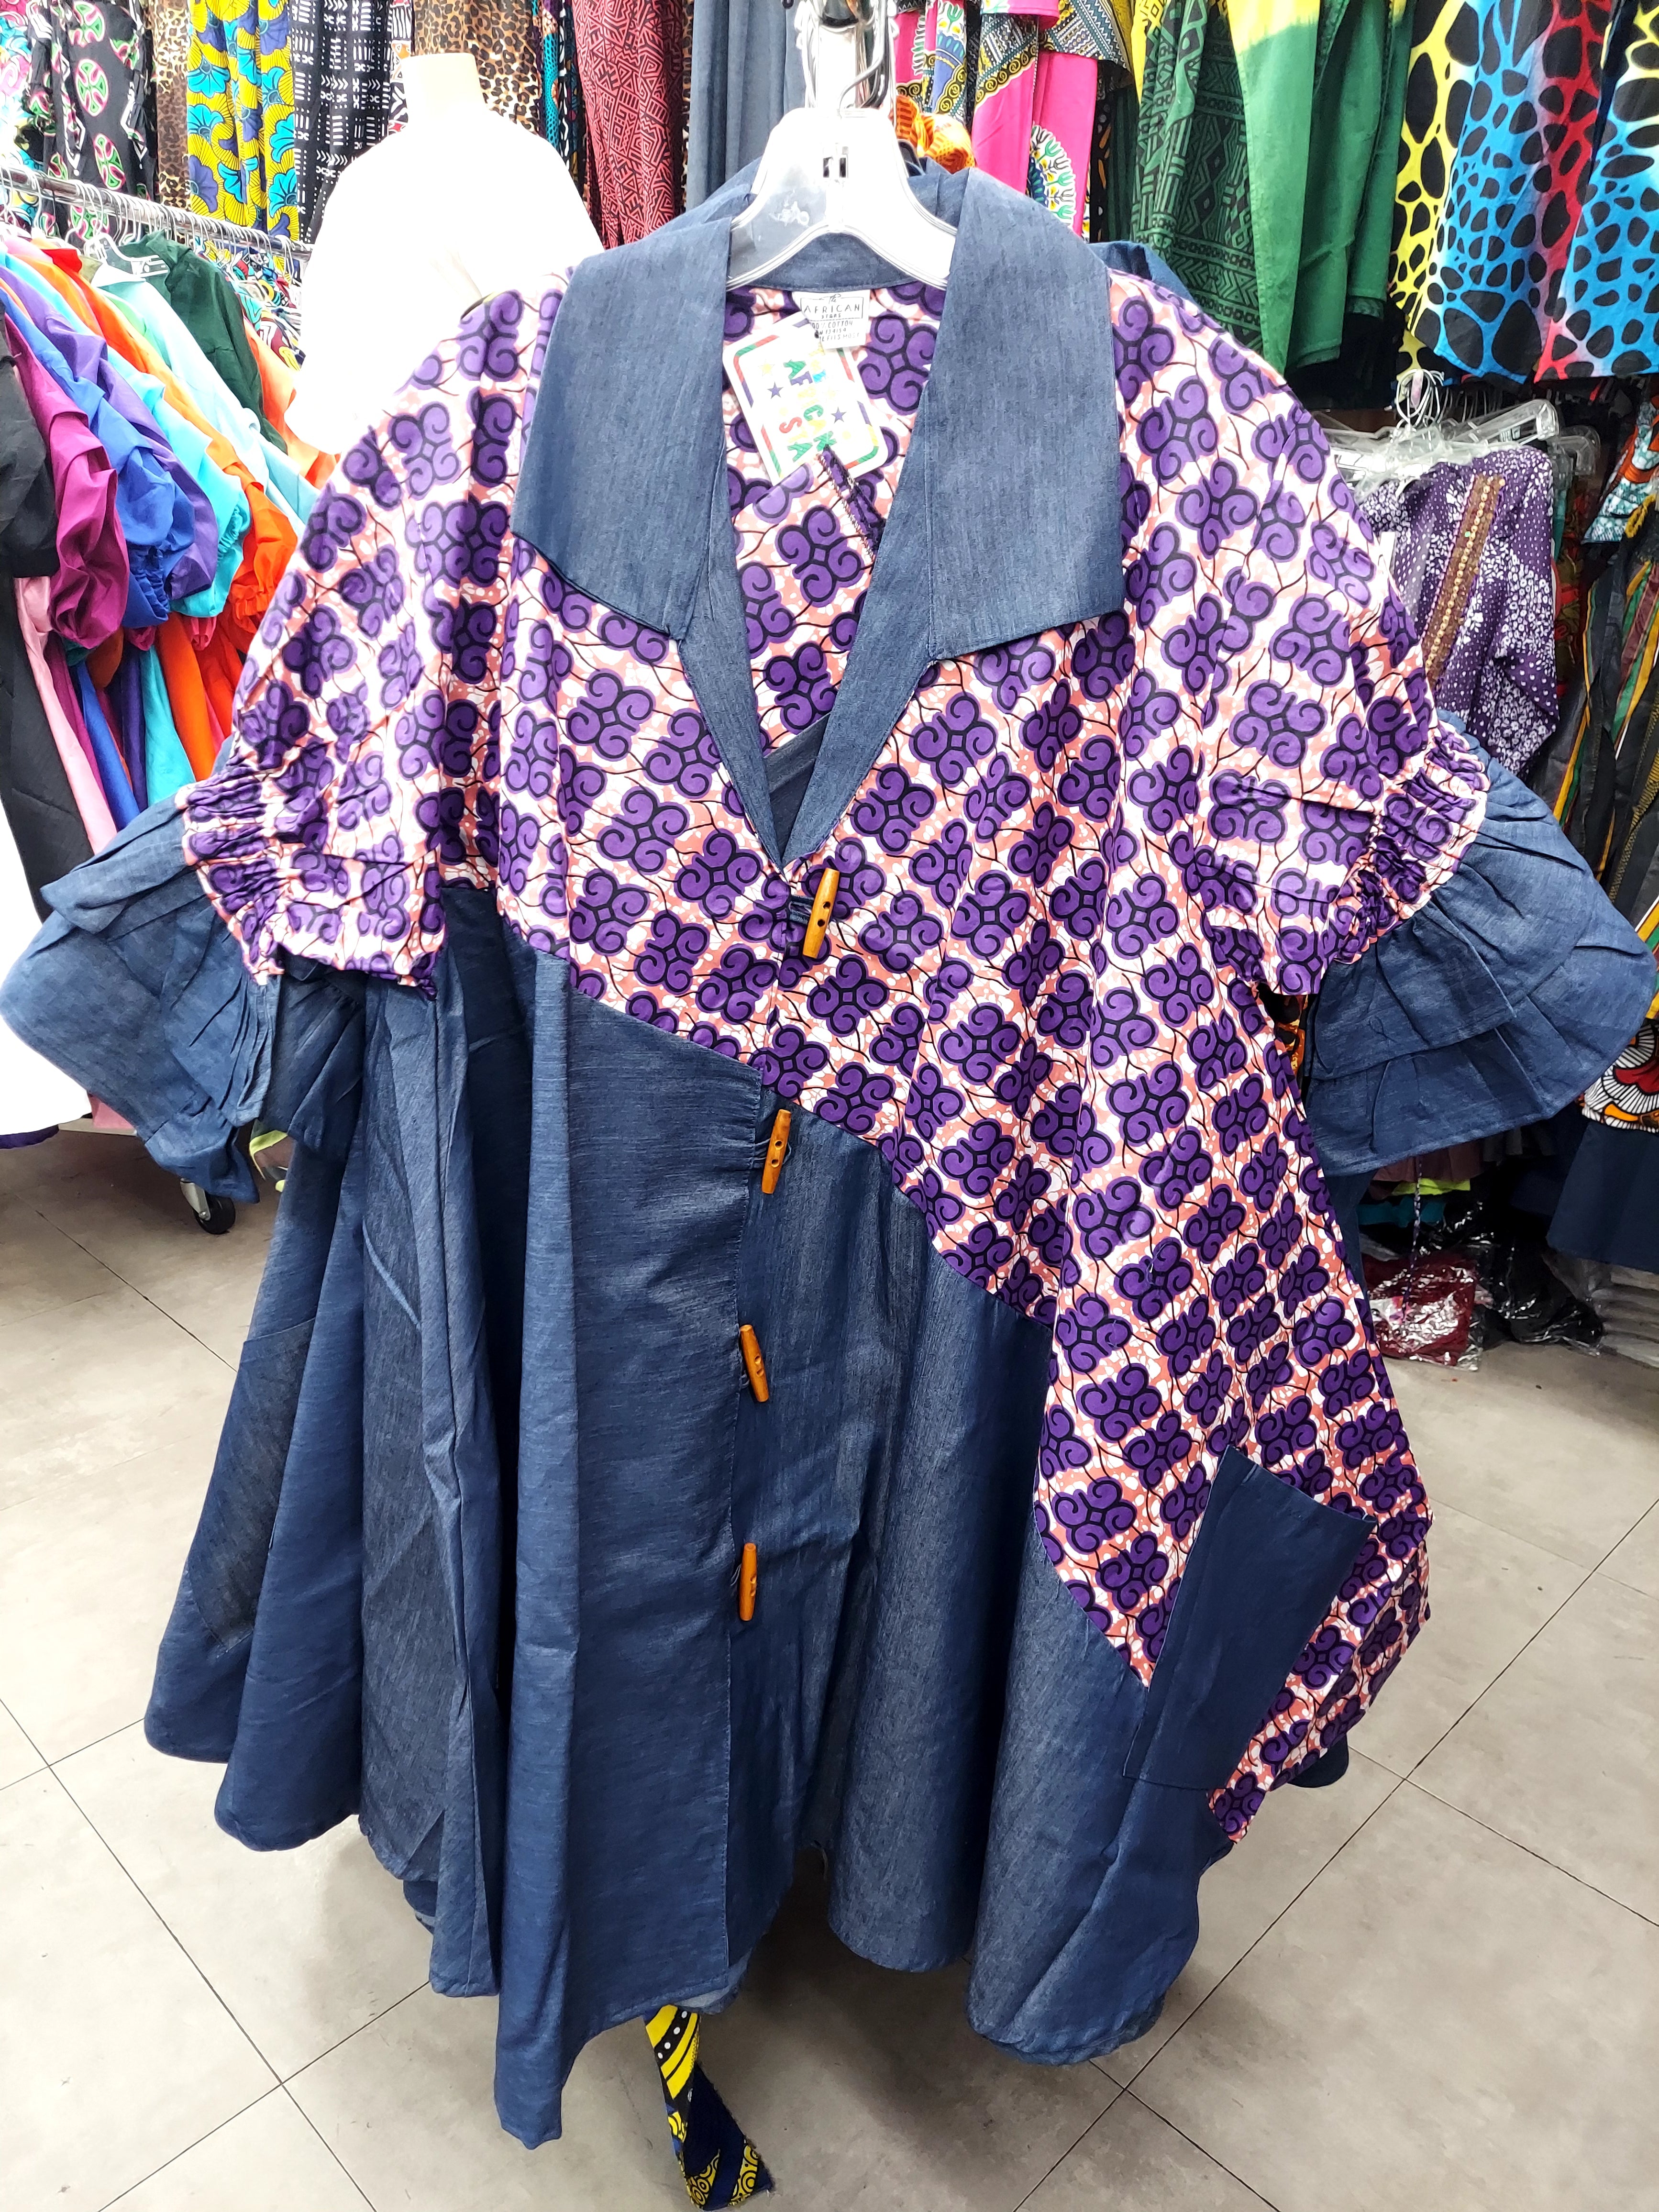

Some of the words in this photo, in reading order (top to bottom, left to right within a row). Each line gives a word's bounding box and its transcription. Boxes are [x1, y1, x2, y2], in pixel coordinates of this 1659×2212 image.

[804, 304, 860, 313] AFRICAN
[828, 320, 853, 328] COTTON
[783, 359, 837, 452] AFRICAN
